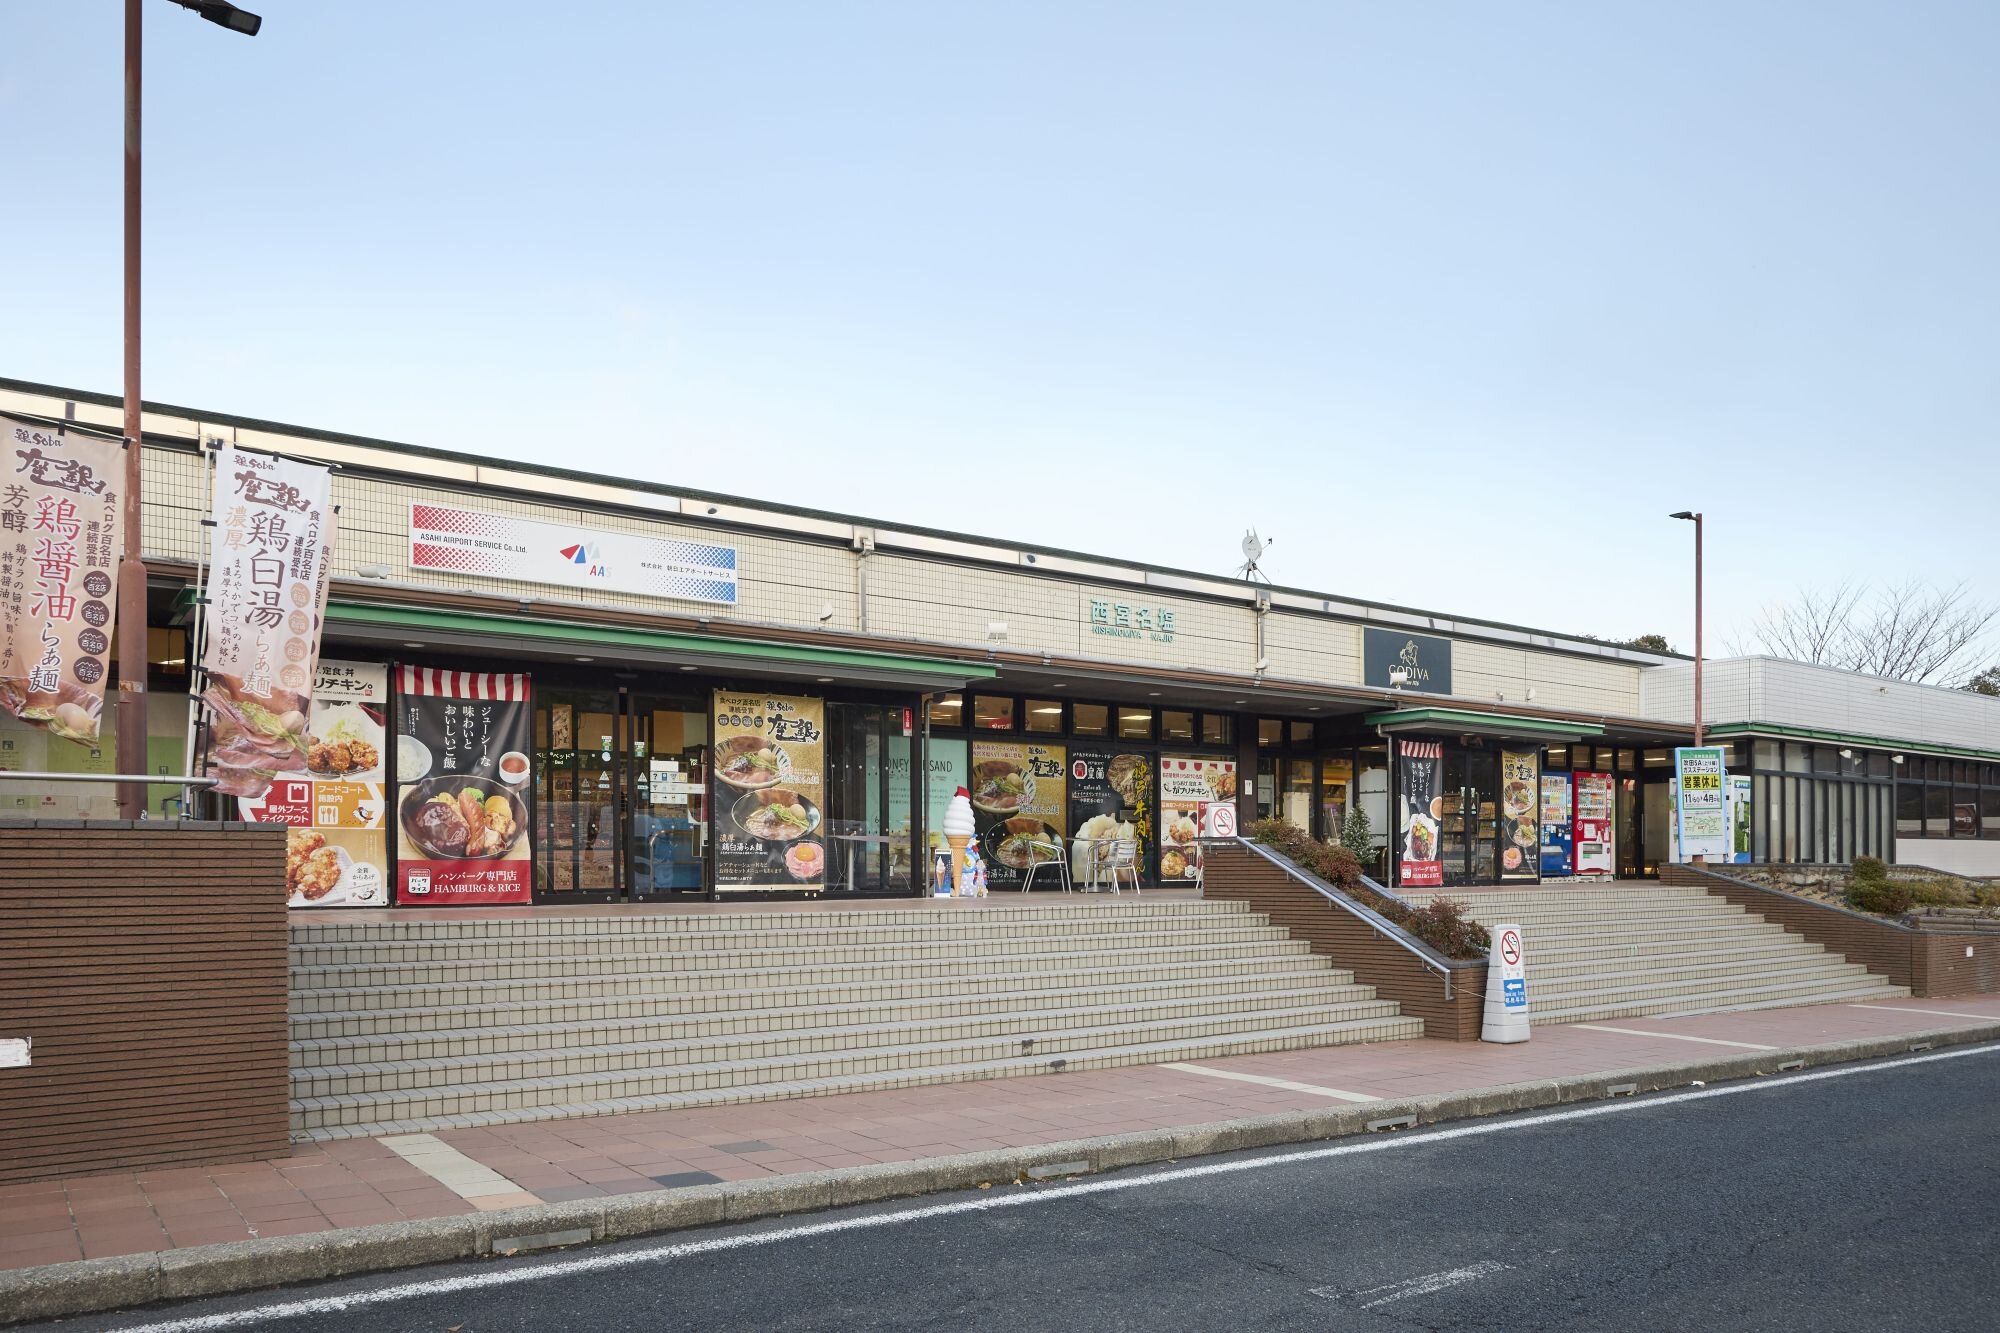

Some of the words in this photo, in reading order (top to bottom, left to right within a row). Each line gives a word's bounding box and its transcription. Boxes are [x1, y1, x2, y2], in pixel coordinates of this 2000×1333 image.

[1, 483, 30, 534] 芳醇
[223, 505, 248, 551] 濃厚
[85, 520, 101, 568] 連続受賞
[420, 533, 442, 542] ASAHI
[443, 536, 472, 547] AIRPORT
[474, 540, 501, 551] SERVICE
[290, 535, 305, 579] 連続受賞
[640, 562, 663, 570] 株式会社
[666, 565, 731, 579] 朝日エアポートサービス
[1091, 600, 1175, 633] 西宮名塩
[1388, 664, 1429, 681] GODIVA
[462, 705, 475, 750] 味わいと
[443, 704, 457, 769] おいしいご飯
[480, 706, 492, 768] ジューシーな
[929, 760, 953, 773] SAND
[318, 785, 364, 795] フードコート
[1684, 775, 1719, 788] 営業休止
[268, 804, 309, 814] 屋外ブース
[260, 814, 310, 824] テイクアウト
[438, 870, 517, 881] ハンバーグ専門店
[434, 884, 486, 893] HAMBURG
[488, 884, 496, 892] &
[498, 883, 521, 892] RICE
